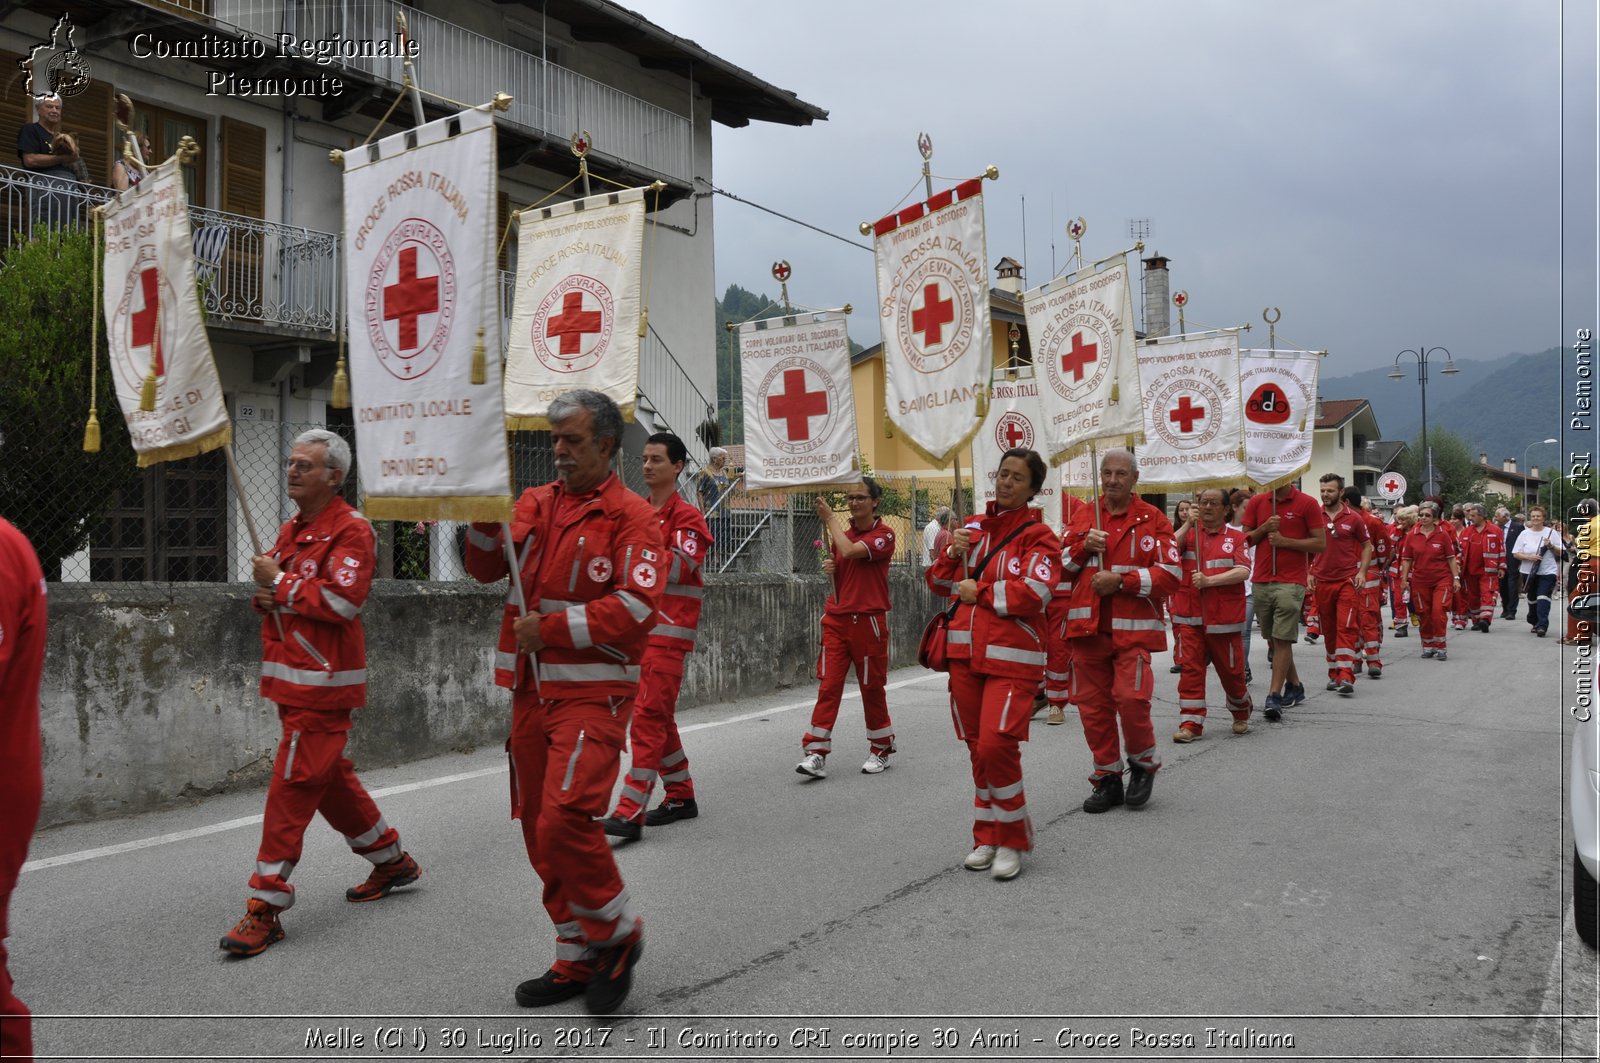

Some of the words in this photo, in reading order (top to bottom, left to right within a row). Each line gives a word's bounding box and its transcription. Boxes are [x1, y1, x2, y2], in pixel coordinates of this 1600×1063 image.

[355, 195, 386, 251] CROCE
[387, 170, 423, 202] ROSSA
[427, 171, 469, 225] ITALIANA
[936, 206, 968, 227] SOCCORSO
[432, 234, 443, 250] 22
[527, 254, 558, 289] CROCE
[557, 241, 590, 263] ROSSA
[881, 267, 904, 318] CROCE
[901, 236, 941, 269] ROSSA
[1077, 285, 1089, 296] DEL
[1089, 271, 1121, 292] SOCCORSO
[533, 298, 550, 362] CONVENZIONE
[550, 291, 560, 301] DI
[559, 277, 595, 293] GINEVRA
[595, 286, 607, 298] 22
[904, 279, 917, 293] DI
[953, 276, 966, 291] 22
[962, 293, 972, 342] AGOSTO
[745, 340, 763, 349] CORPO
[797, 332, 808, 342] DEL
[810, 328, 839, 341] SOCCORSO
[1037, 323, 1055, 364] CROCE
[1054, 299, 1086, 324] ROSSA
[1088, 299, 1124, 337] ITALIANA
[742, 349, 772, 360] CROCE
[773, 345, 804, 356] ROSSA
[806, 338, 846, 353] ITALIANA
[1051, 334, 1062, 345] DI
[1091, 319, 1104, 332] 22
[1100, 330, 1111, 369] AGOSTO
[1156, 353, 1185, 364] VOLONTARI
[1198, 347, 1232, 359] SOCCORSO
[759, 358, 797, 398] CONVENZIONE
[800, 358, 808, 368] DI
[809, 361, 834, 391] GINEVRA
[1254, 366, 1278, 375] ITALIANA
[1278, 368, 1302, 385] DONATORI
[186, 388, 204, 404] DI
[1142, 378, 1164, 410] CROCE
[1163, 365, 1195, 381] ROSSA
[1198, 367, 1232, 402] ITALIANA
[242, 407, 253, 416] 22
[420, 399, 472, 418] LOCALE
[1160, 392, 1169, 400] DI
[1168, 381, 1200, 392] GINEVRA
[1201, 387, 1212, 396] 22
[1209, 394, 1219, 429] AGOSTO
[404, 430, 416, 445] DI
[1253, 431, 1306, 441] INTERCOMUNALE
[762, 454, 828, 467] DELEGAZIONE
[831, 452, 841, 463] DI
[1140, 455, 1178, 466] GRUPPO
[1179, 455, 1188, 464] DI
[1255, 456, 1277, 465] VALLE
[1278, 443, 1307, 464] VARAITA
[382, 457, 448, 477] DRONERO
[764, 465, 838, 480] PEVERAGNO
[1080, 461, 1089, 469] DI
